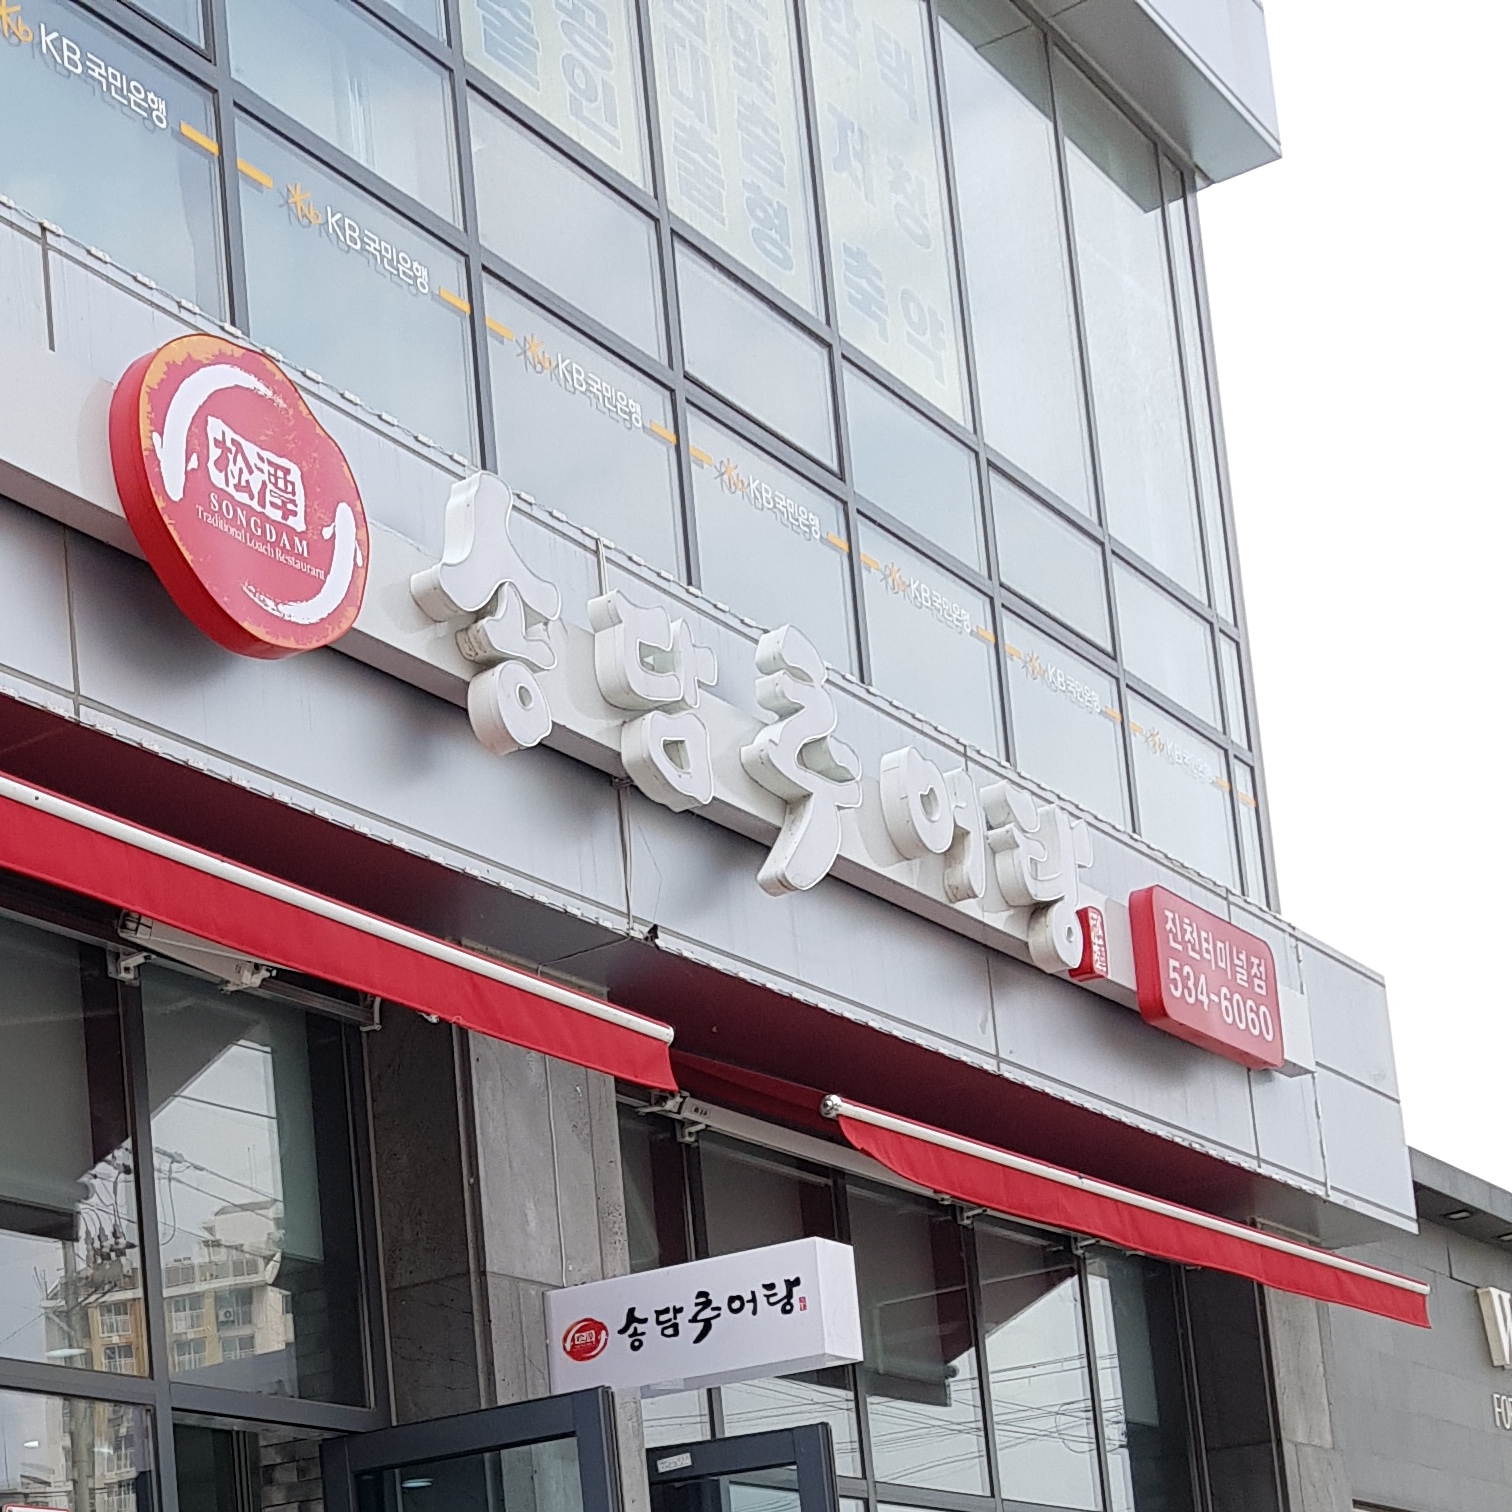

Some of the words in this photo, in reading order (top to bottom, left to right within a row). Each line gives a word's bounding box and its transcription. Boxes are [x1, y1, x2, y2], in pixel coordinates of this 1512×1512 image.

[39, 23, 168, 129] KB국민은행
[326, 206, 430, 293] KB국민은행
[196, 504, 246, 543] Traditional
[246, 533, 274, 560] Loach
[275, 547, 326, 580] Restaurant
[209, 492, 309, 558] SONGDAM
[1164, 909, 1268, 996] 진천터미널점
[1168, 958, 1274, 1042] 534-6060
[617, 1276, 801, 1352] 송담추어탕
